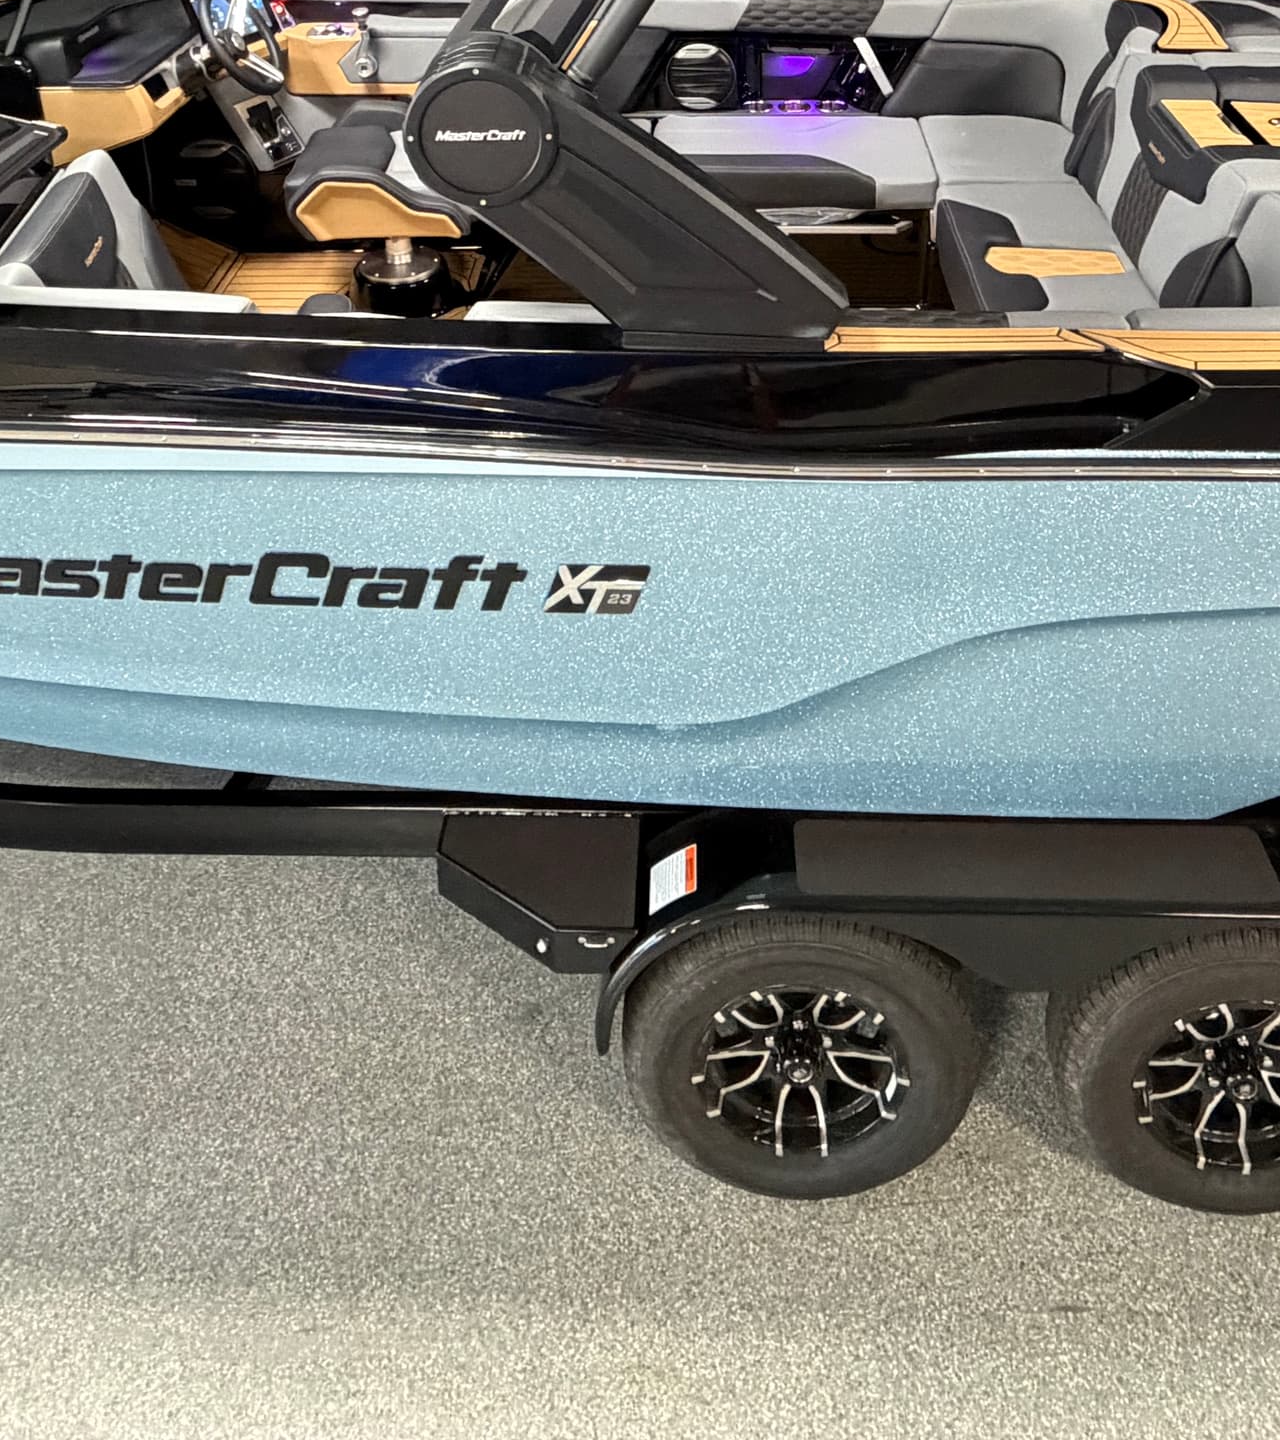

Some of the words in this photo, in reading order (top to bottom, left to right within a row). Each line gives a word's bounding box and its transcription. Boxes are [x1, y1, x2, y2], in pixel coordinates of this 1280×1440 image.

[435, 129, 526, 141] MasterCraft
[544, 564, 646, 614] XT
[607, 593, 632, 605] 23
